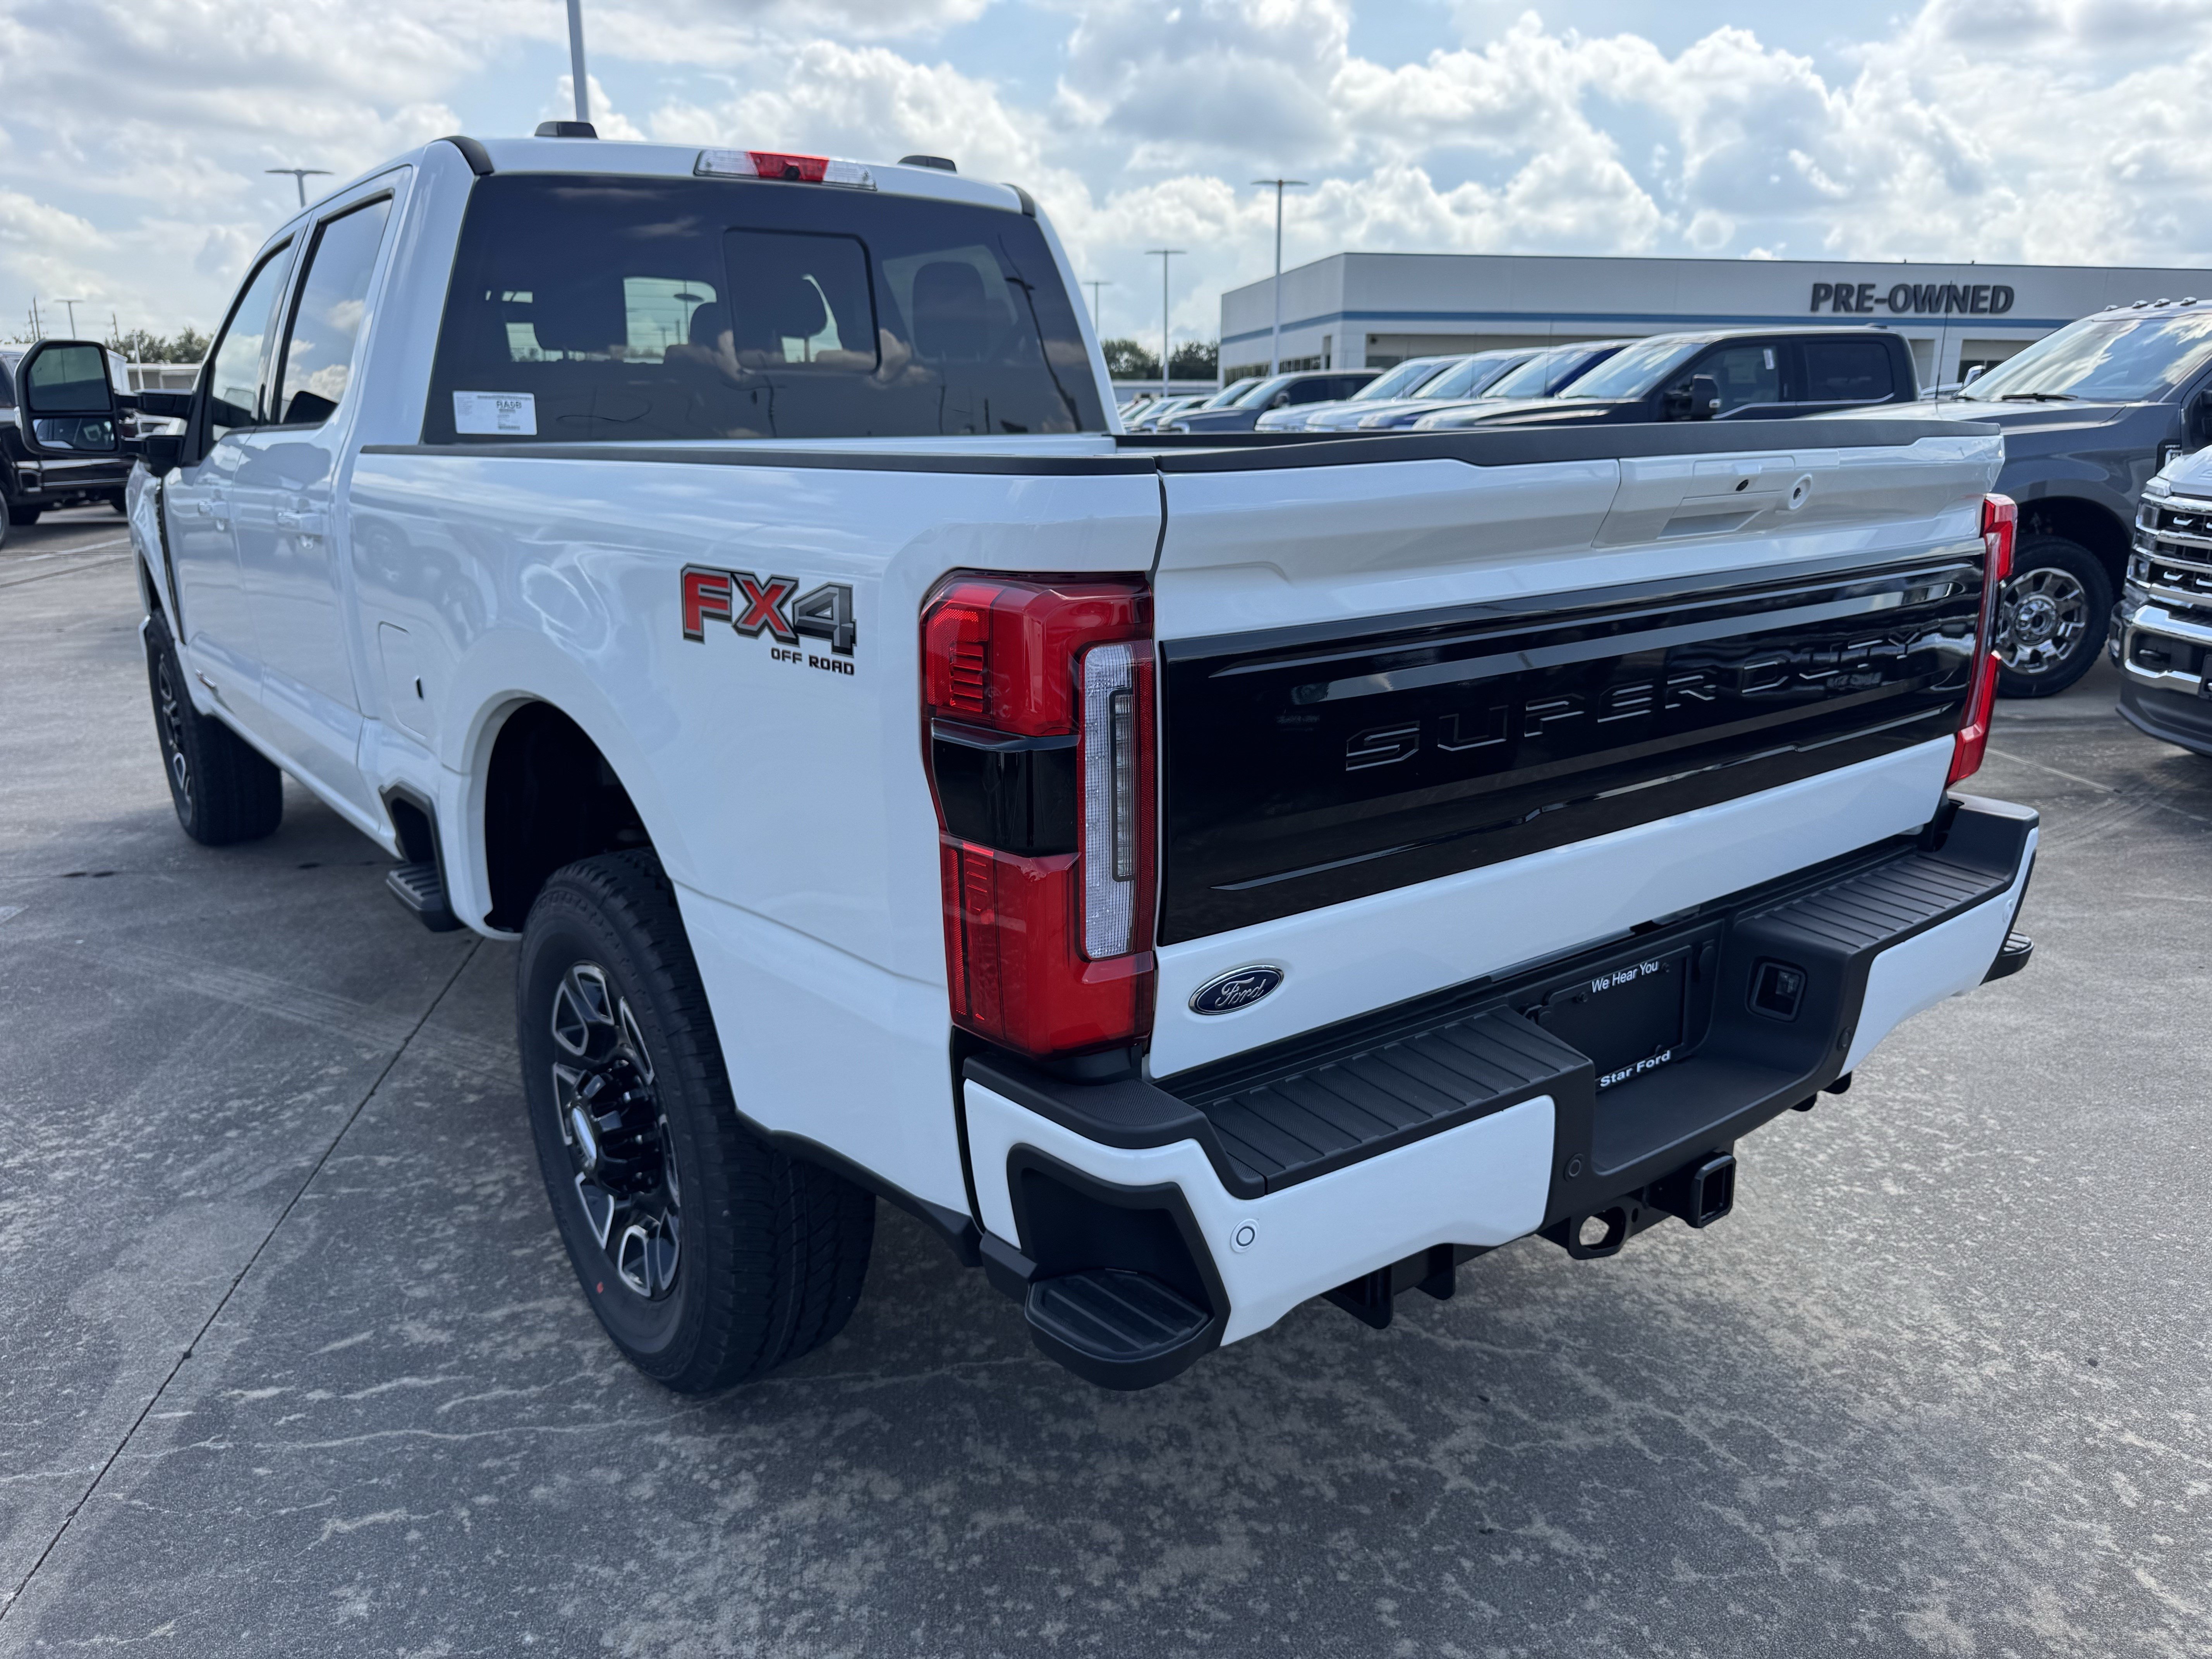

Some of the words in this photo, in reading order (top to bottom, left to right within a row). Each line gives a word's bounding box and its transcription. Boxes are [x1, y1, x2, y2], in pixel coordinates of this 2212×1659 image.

[1810, 283, 2014, 314] PRE-OWNED
[680, 562, 857, 658] FX4
[771, 647, 802, 664] OFF
[808, 654, 855, 676] ROAD
[1345, 663, 1718, 771] SUPER
[1741, 624, 1924, 694] DUTY
[1215, 977, 1266, 1010] Ford
[1592, 977, 1610, 993] We
[1612, 968, 1638, 986] Hear
[1640, 961, 1660, 976] You
[1600, 1067, 1633, 1087] Star
[1637, 1049, 1671, 1073] Ford
